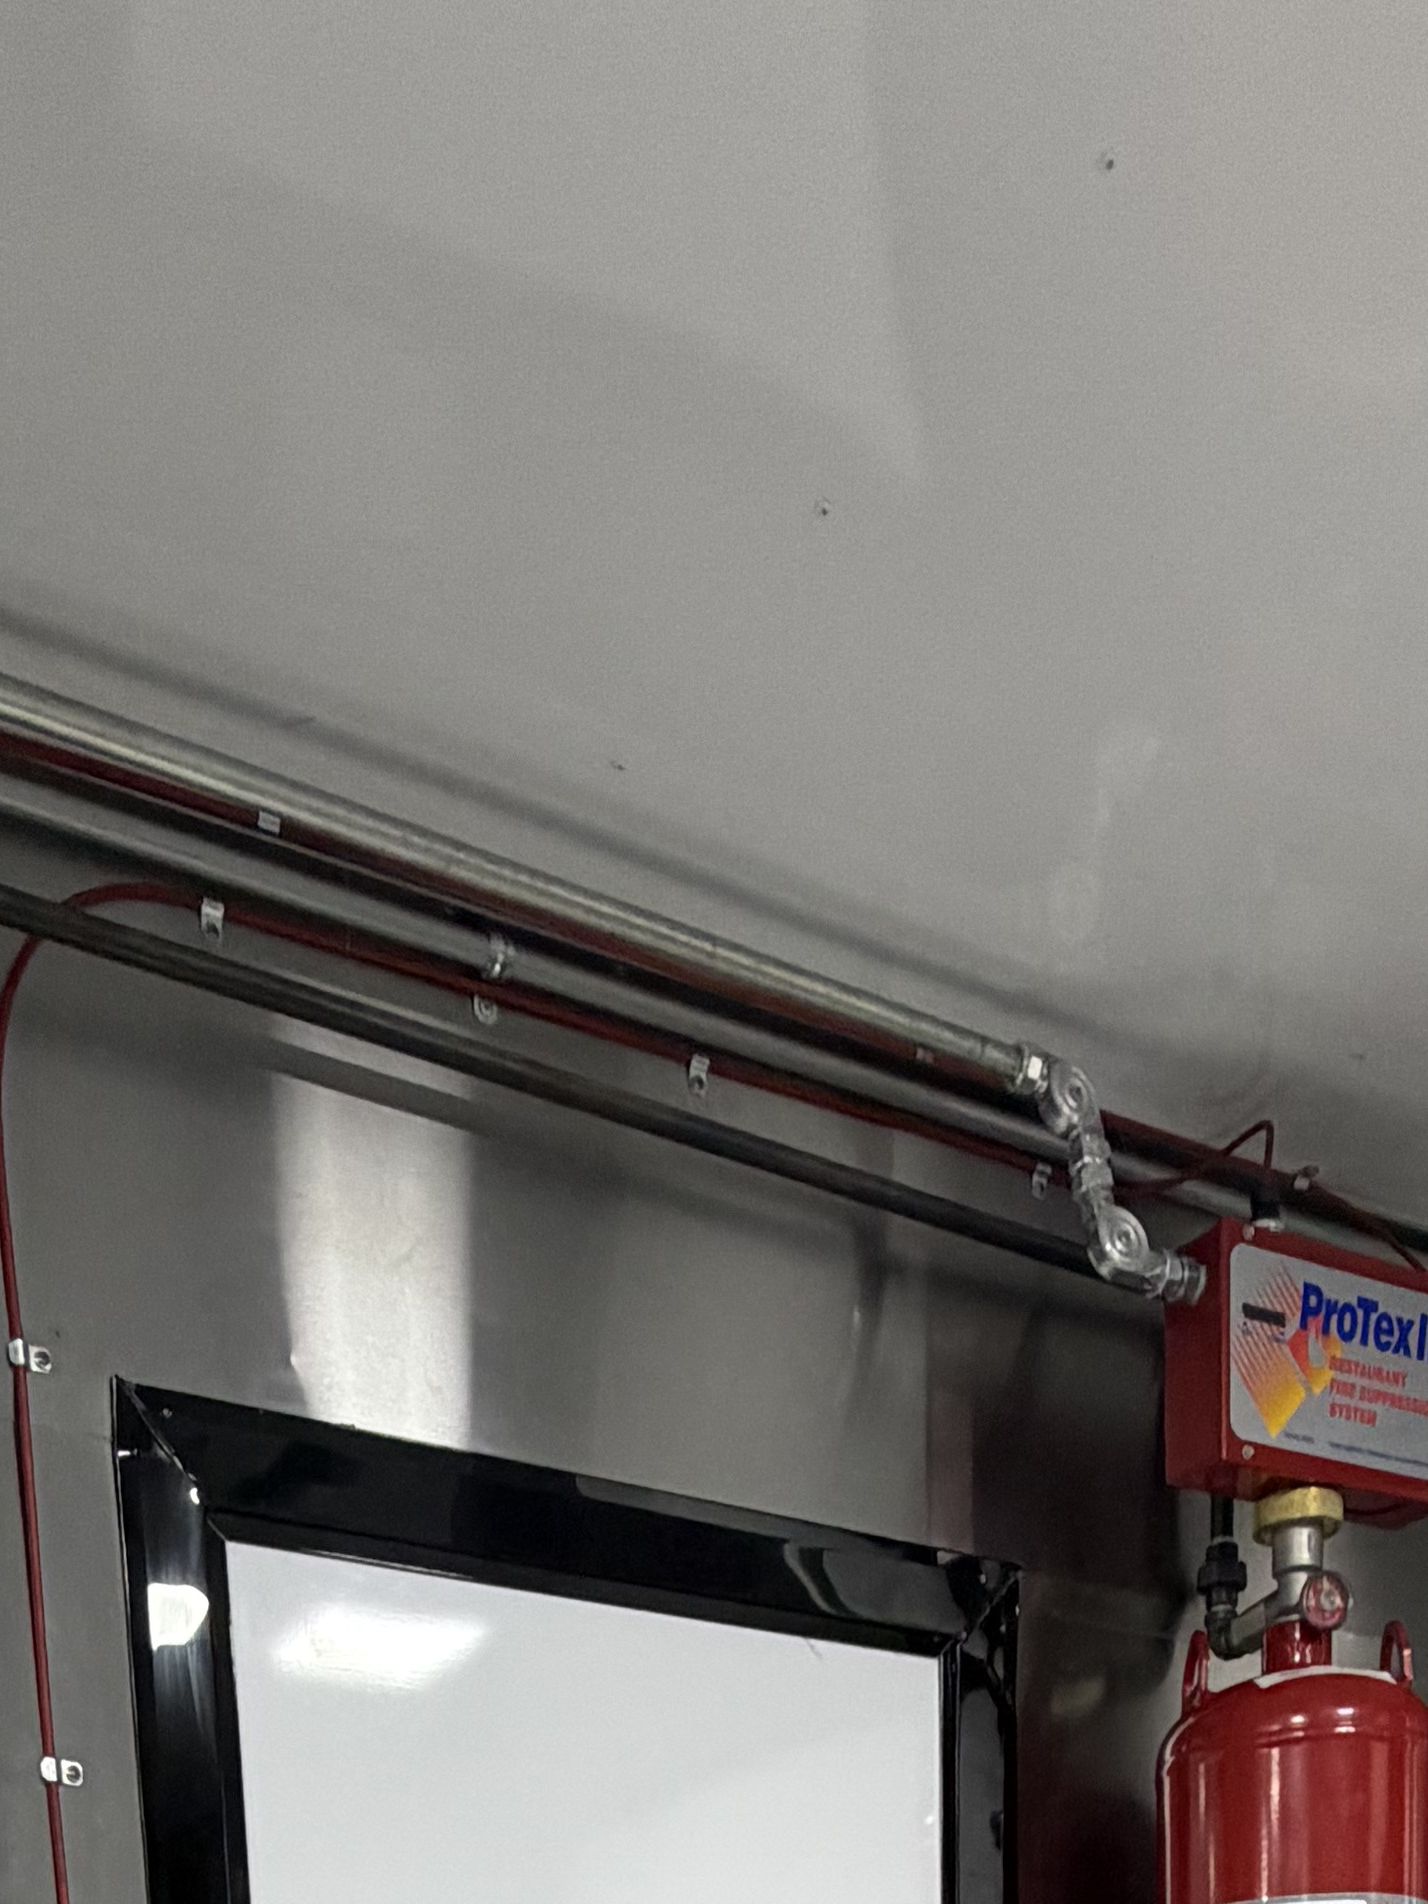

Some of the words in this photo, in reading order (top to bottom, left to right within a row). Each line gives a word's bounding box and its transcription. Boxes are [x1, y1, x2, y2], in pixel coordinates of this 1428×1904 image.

[1299, 1281, 1414, 1360] ProTex
[1329, 1356, 1408, 1388] RESTAURANT
[1330, 1378, 1357, 1399] FIRE
[1329, 1402, 1377, 1428] SYSTEM
